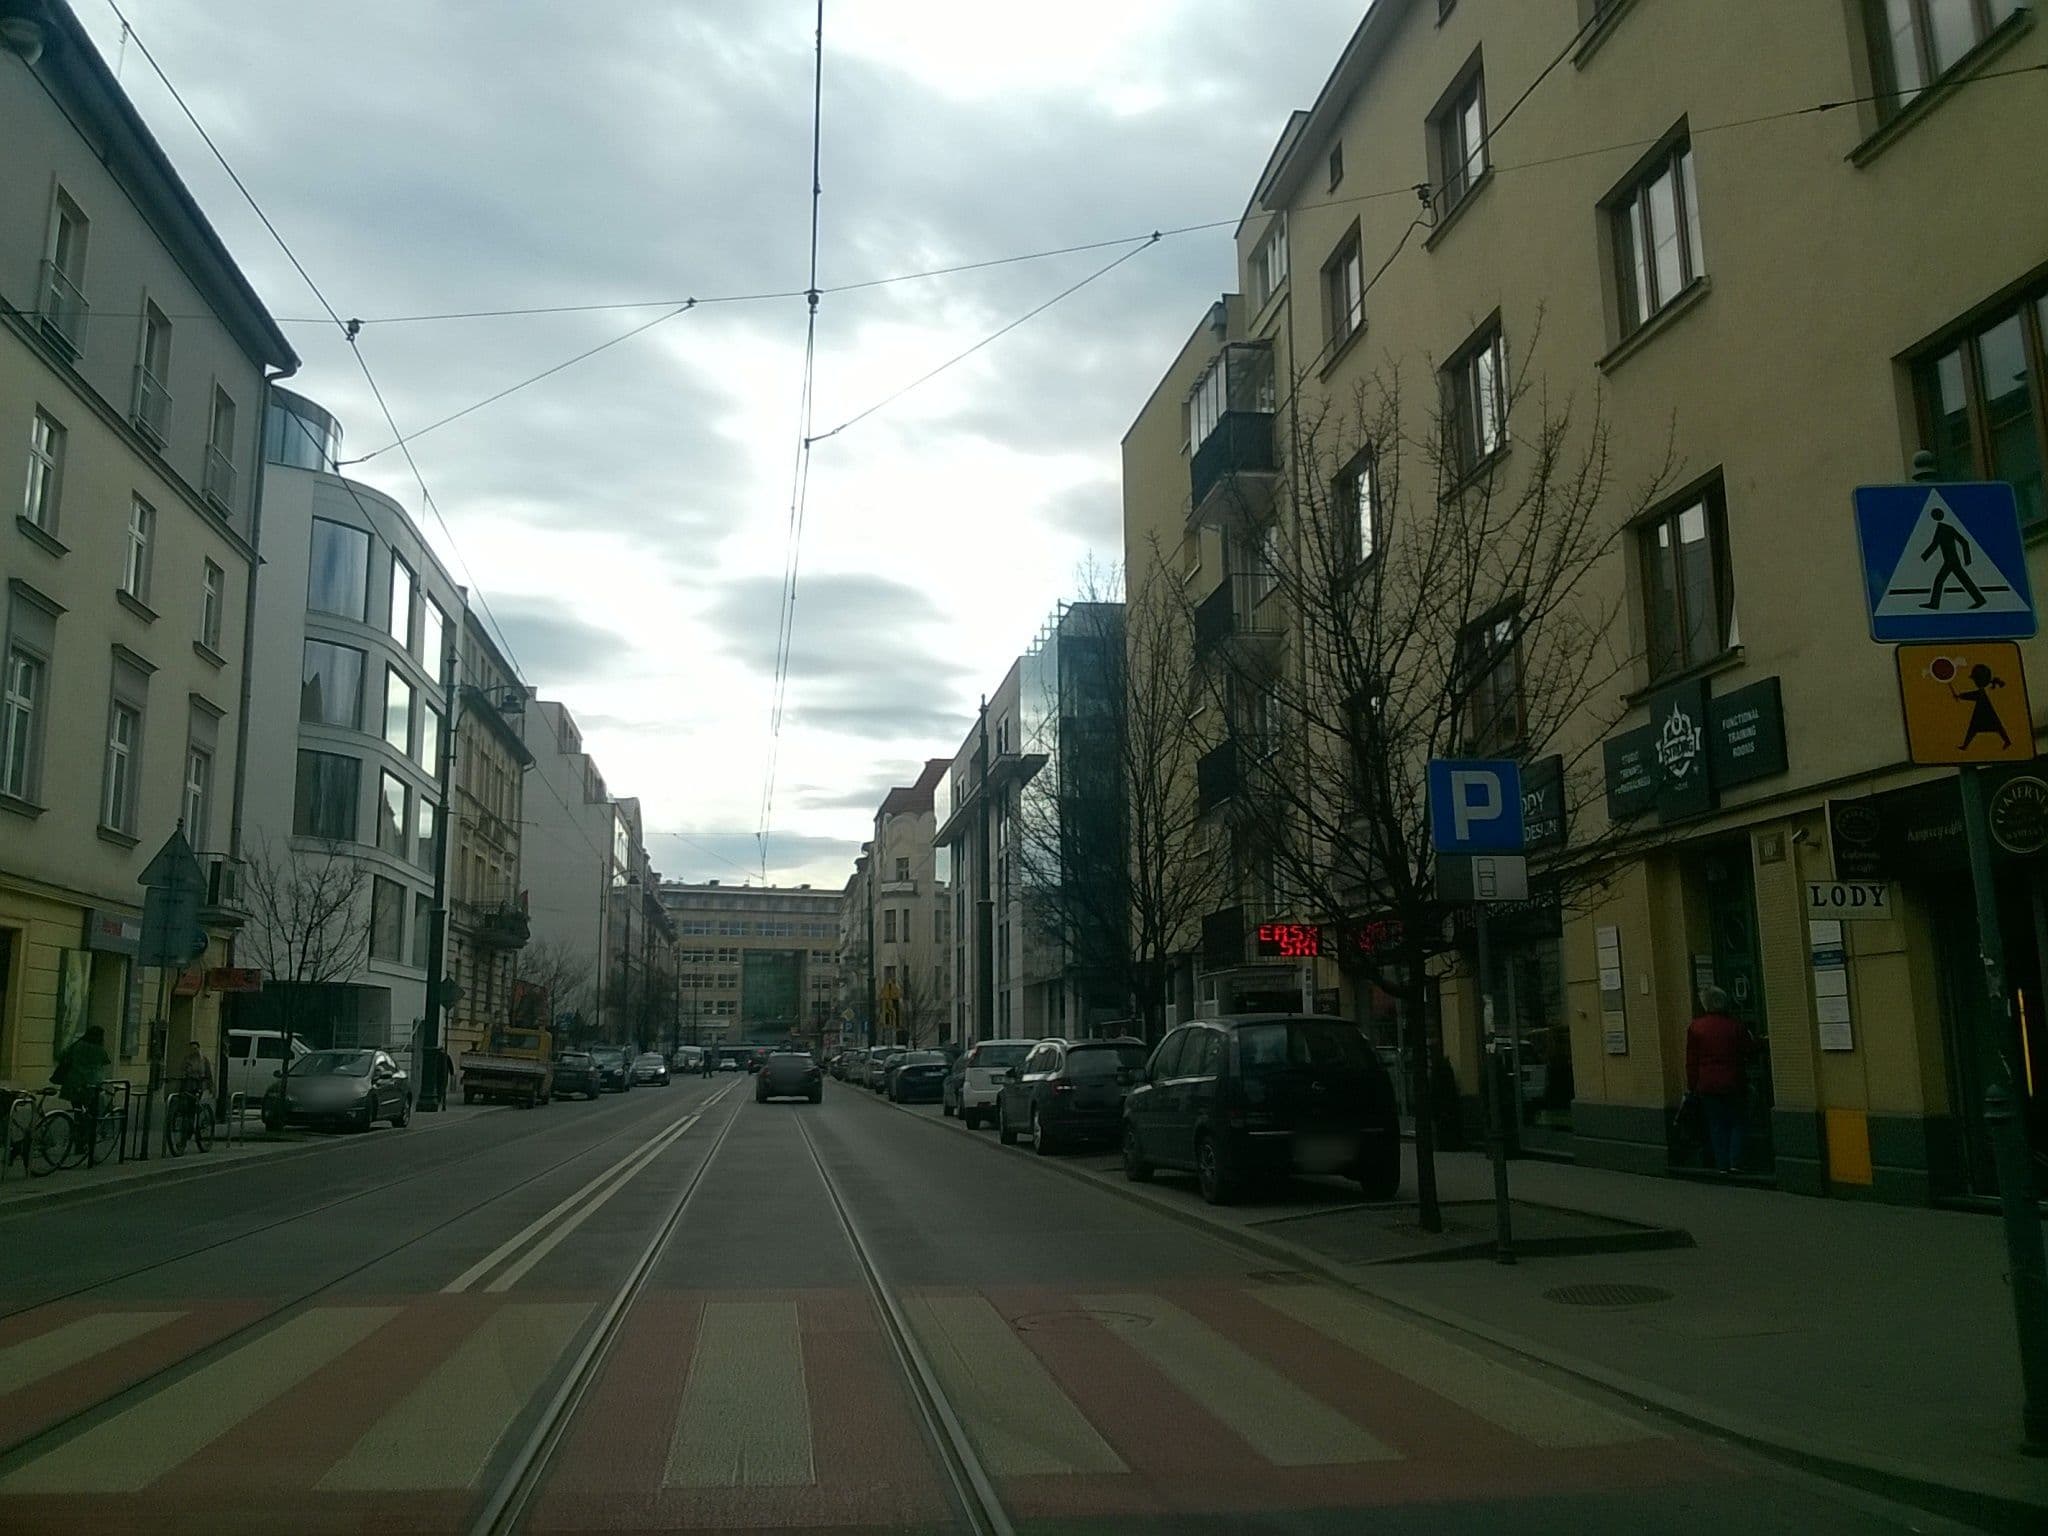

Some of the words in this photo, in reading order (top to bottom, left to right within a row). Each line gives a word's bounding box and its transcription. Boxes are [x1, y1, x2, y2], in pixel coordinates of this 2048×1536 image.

[1721, 707, 1760, 731] FUNCTIONAL
[1727, 725, 1757, 744] TRAINING
[1450, 770, 1503, 841] P
[1810, 885, 1886, 907] LODY
